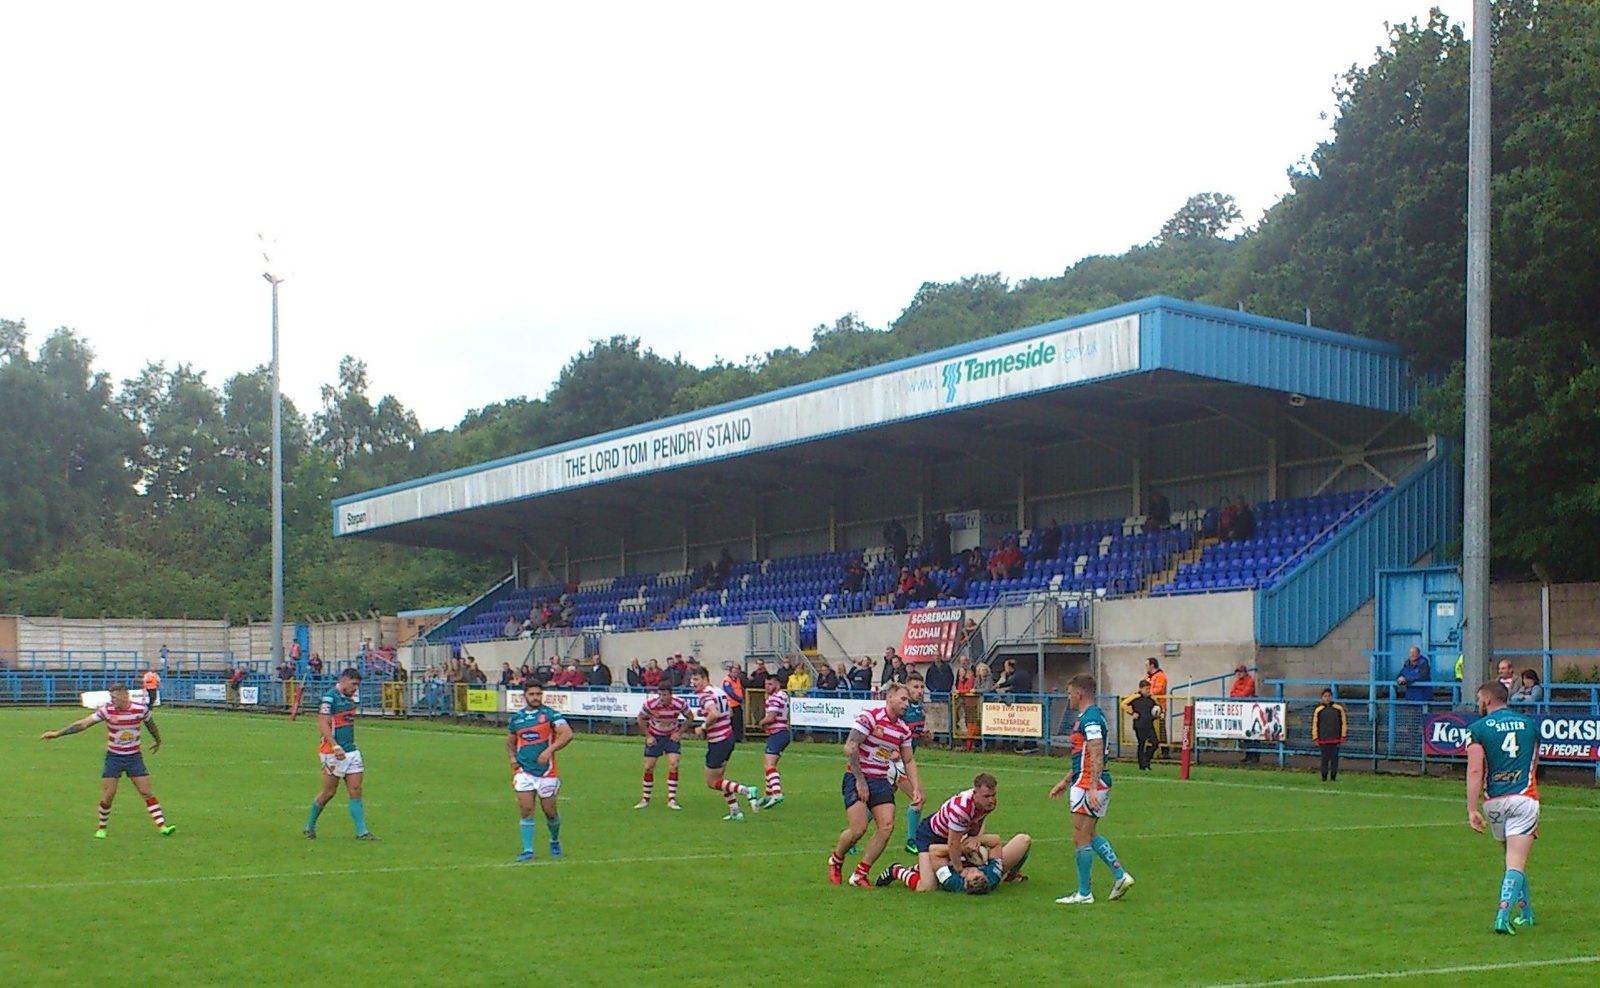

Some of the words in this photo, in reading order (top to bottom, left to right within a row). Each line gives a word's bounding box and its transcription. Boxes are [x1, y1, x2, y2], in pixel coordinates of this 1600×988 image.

[964, 342, 1056, 382] Tameside
[566, 456, 586, 478] THE
[590, 448, 619, 473] LORD
[623, 441, 648, 466] TOM
[653, 429, 703, 461] PENDRY
[707, 418, 751, 448] STAND
[911, 610, 961, 624] SCOREBOARD
[908, 627, 941, 640] OLDHAM
[904, 644, 938, 656] VISITORS
[718, 695, 728, 713] 17
[825, 702, 845, 718] Kappa
[1214, 703, 1225, 716] THE
[1227, 704, 1243, 716] BEST
[1196, 718, 1213, 730] GYMS
[1215, 719, 1222, 730] IN
[1224, 718, 1243, 731] TOWN
[1495, 721, 1525, 733] SALTER
[1501, 731, 1519, 758] 4
[1553, 744, 1592, 757] PEOPLE
